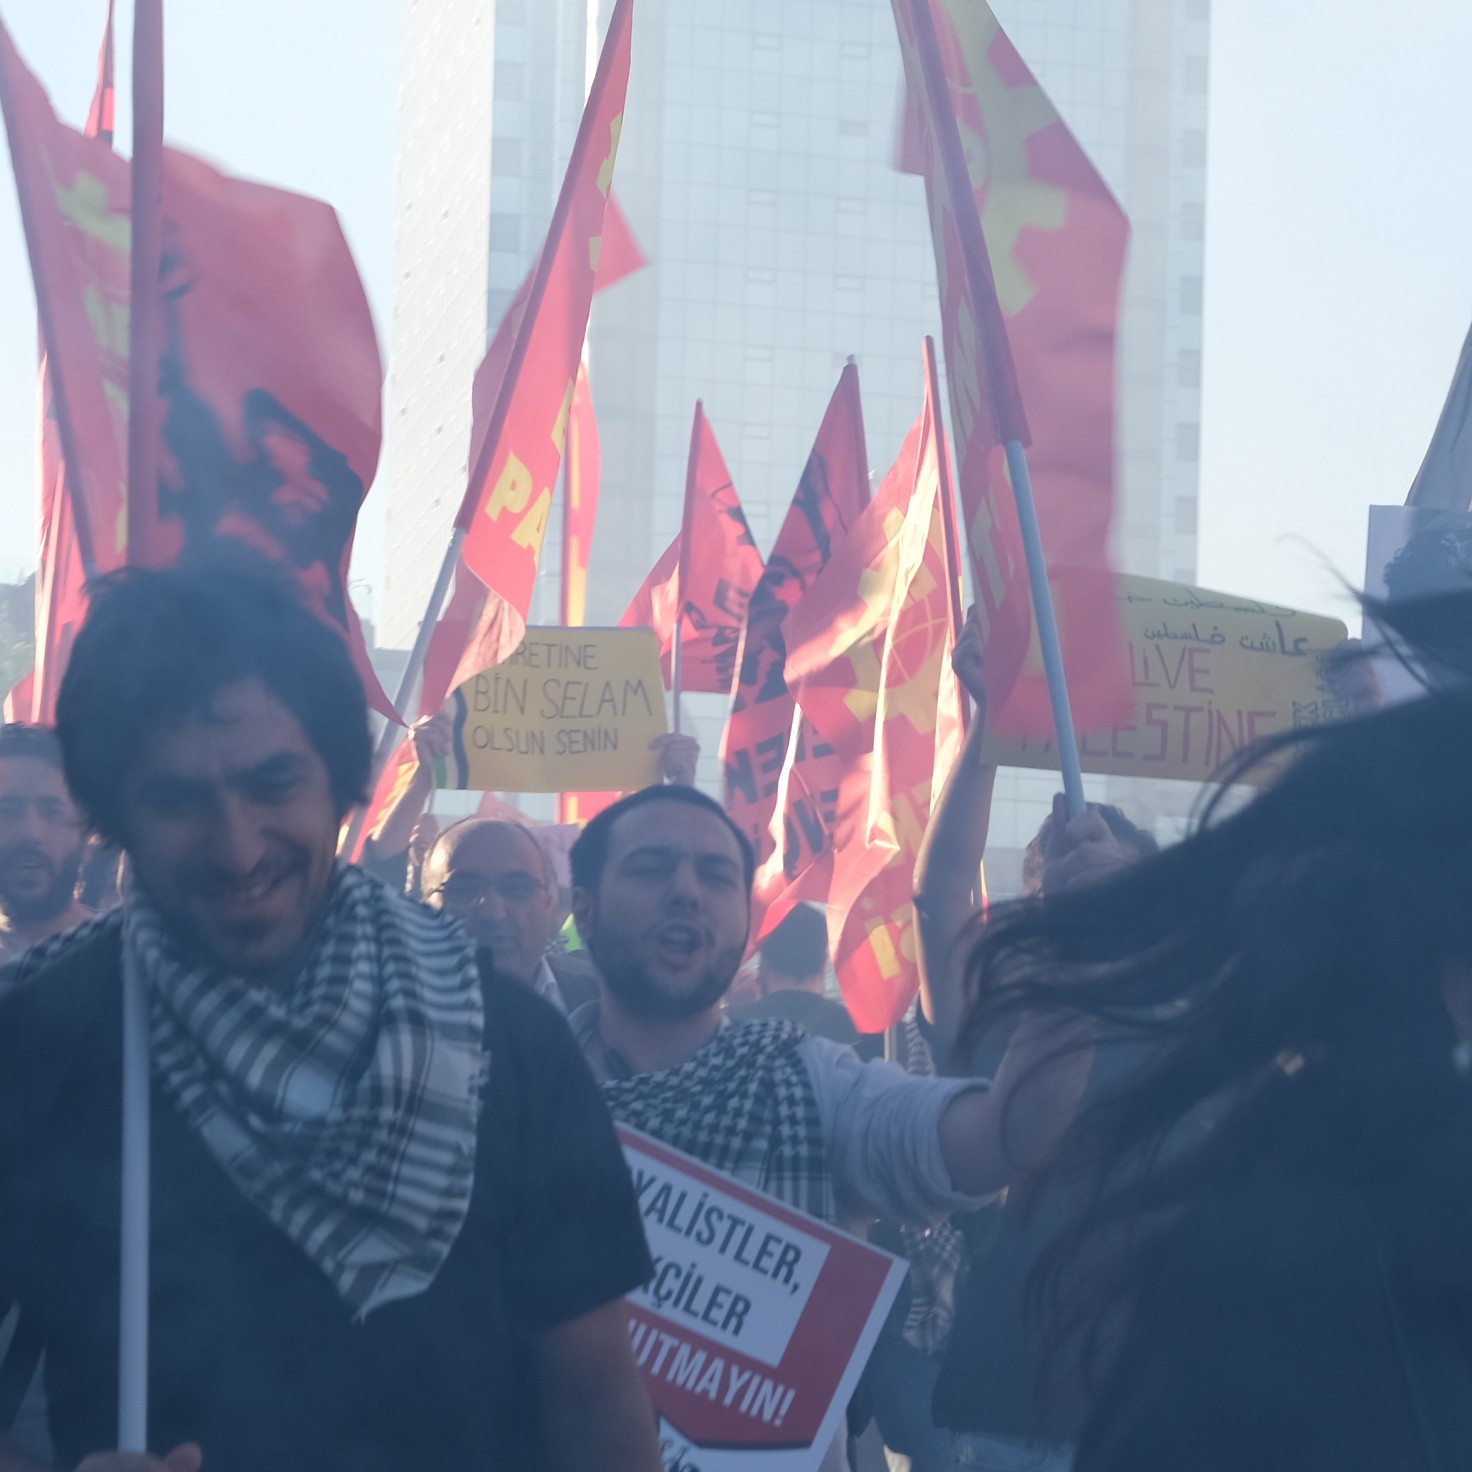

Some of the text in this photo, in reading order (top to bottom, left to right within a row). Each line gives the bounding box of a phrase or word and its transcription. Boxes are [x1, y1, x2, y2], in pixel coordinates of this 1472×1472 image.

[509, 641, 599, 671] RETİNE
[1239, 620, 1311, 657] عاشت
[473, 672, 654, 721] BİN SELAM
[471, 724, 619, 757] OLSUN SENİN
[628, 1317, 797, 1429] UTMAYIN!
